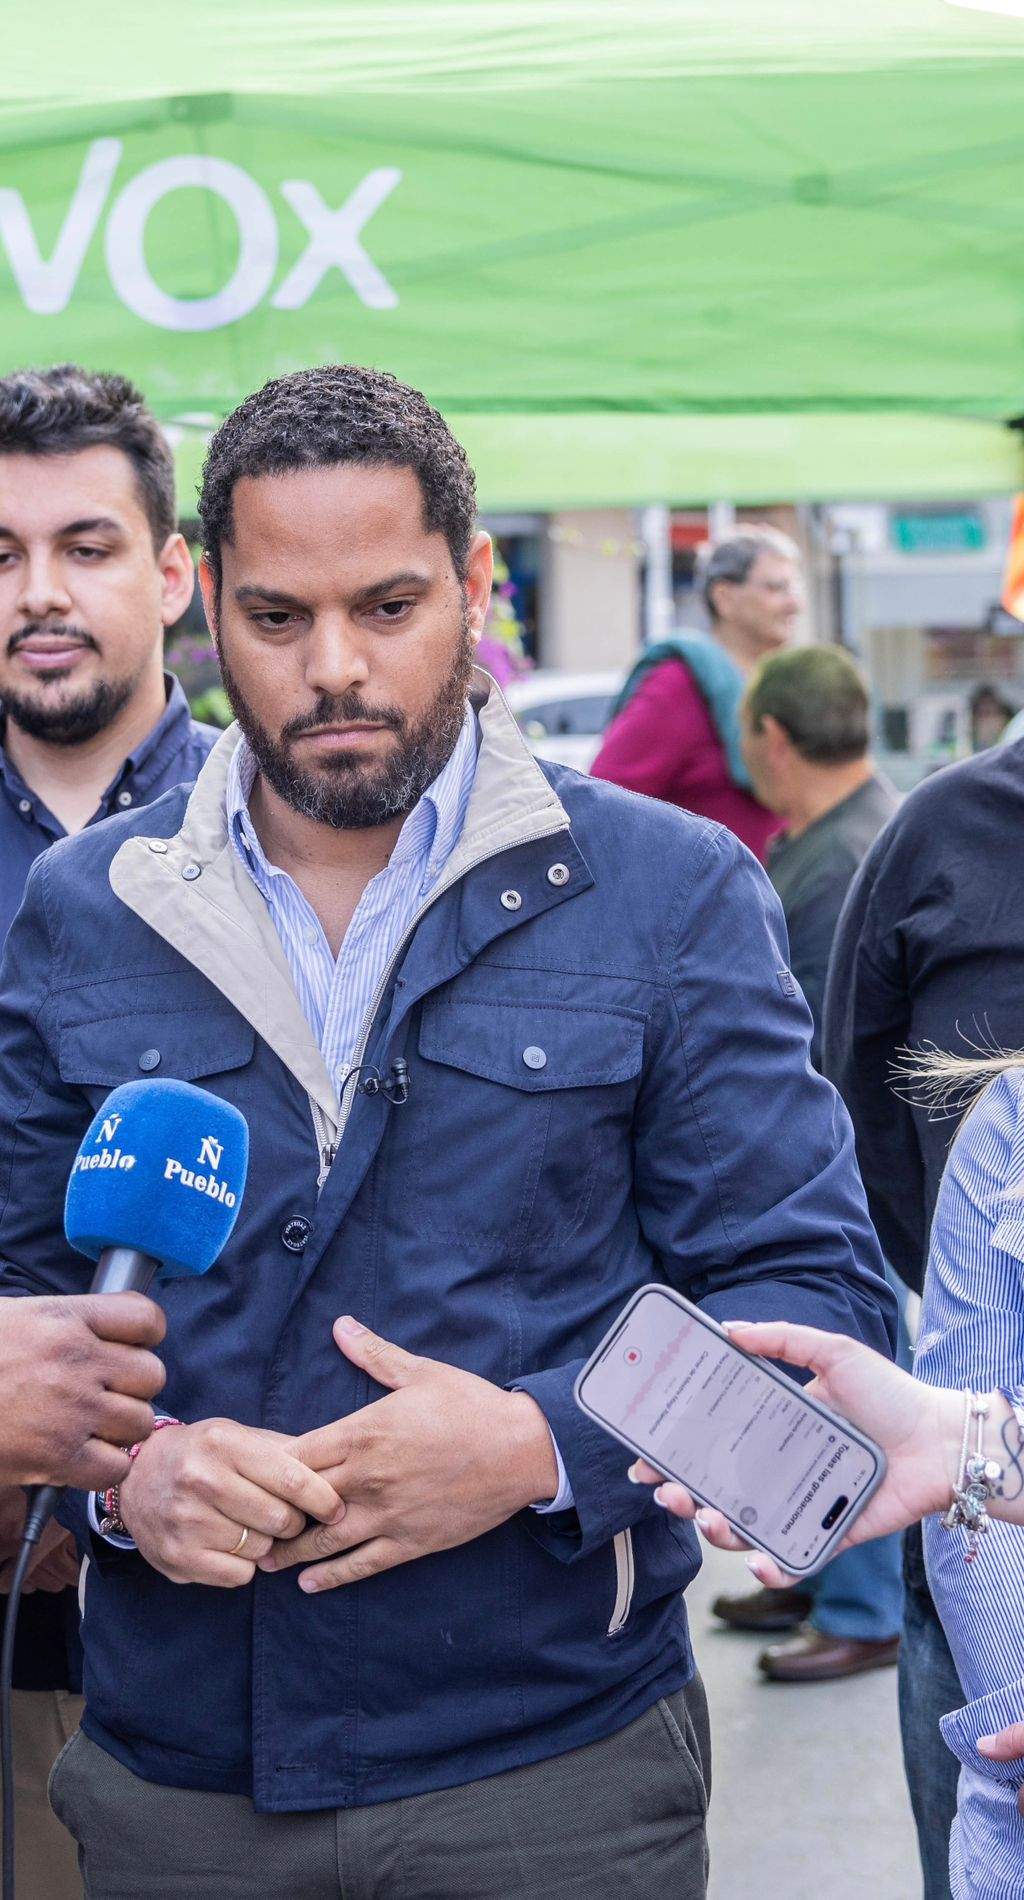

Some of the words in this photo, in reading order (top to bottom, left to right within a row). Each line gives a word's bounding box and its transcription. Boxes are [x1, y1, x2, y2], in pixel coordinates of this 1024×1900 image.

[95, 1113, 122, 1144] Ñ
[196, 1135, 224, 1170] Ñ
[163, 1157, 236, 1208] Pueblo
[827, 1441, 849, 1469] Todas
[817, 1467, 830, 1483] las
[780, 1480, 821, 1536] grabaciones
